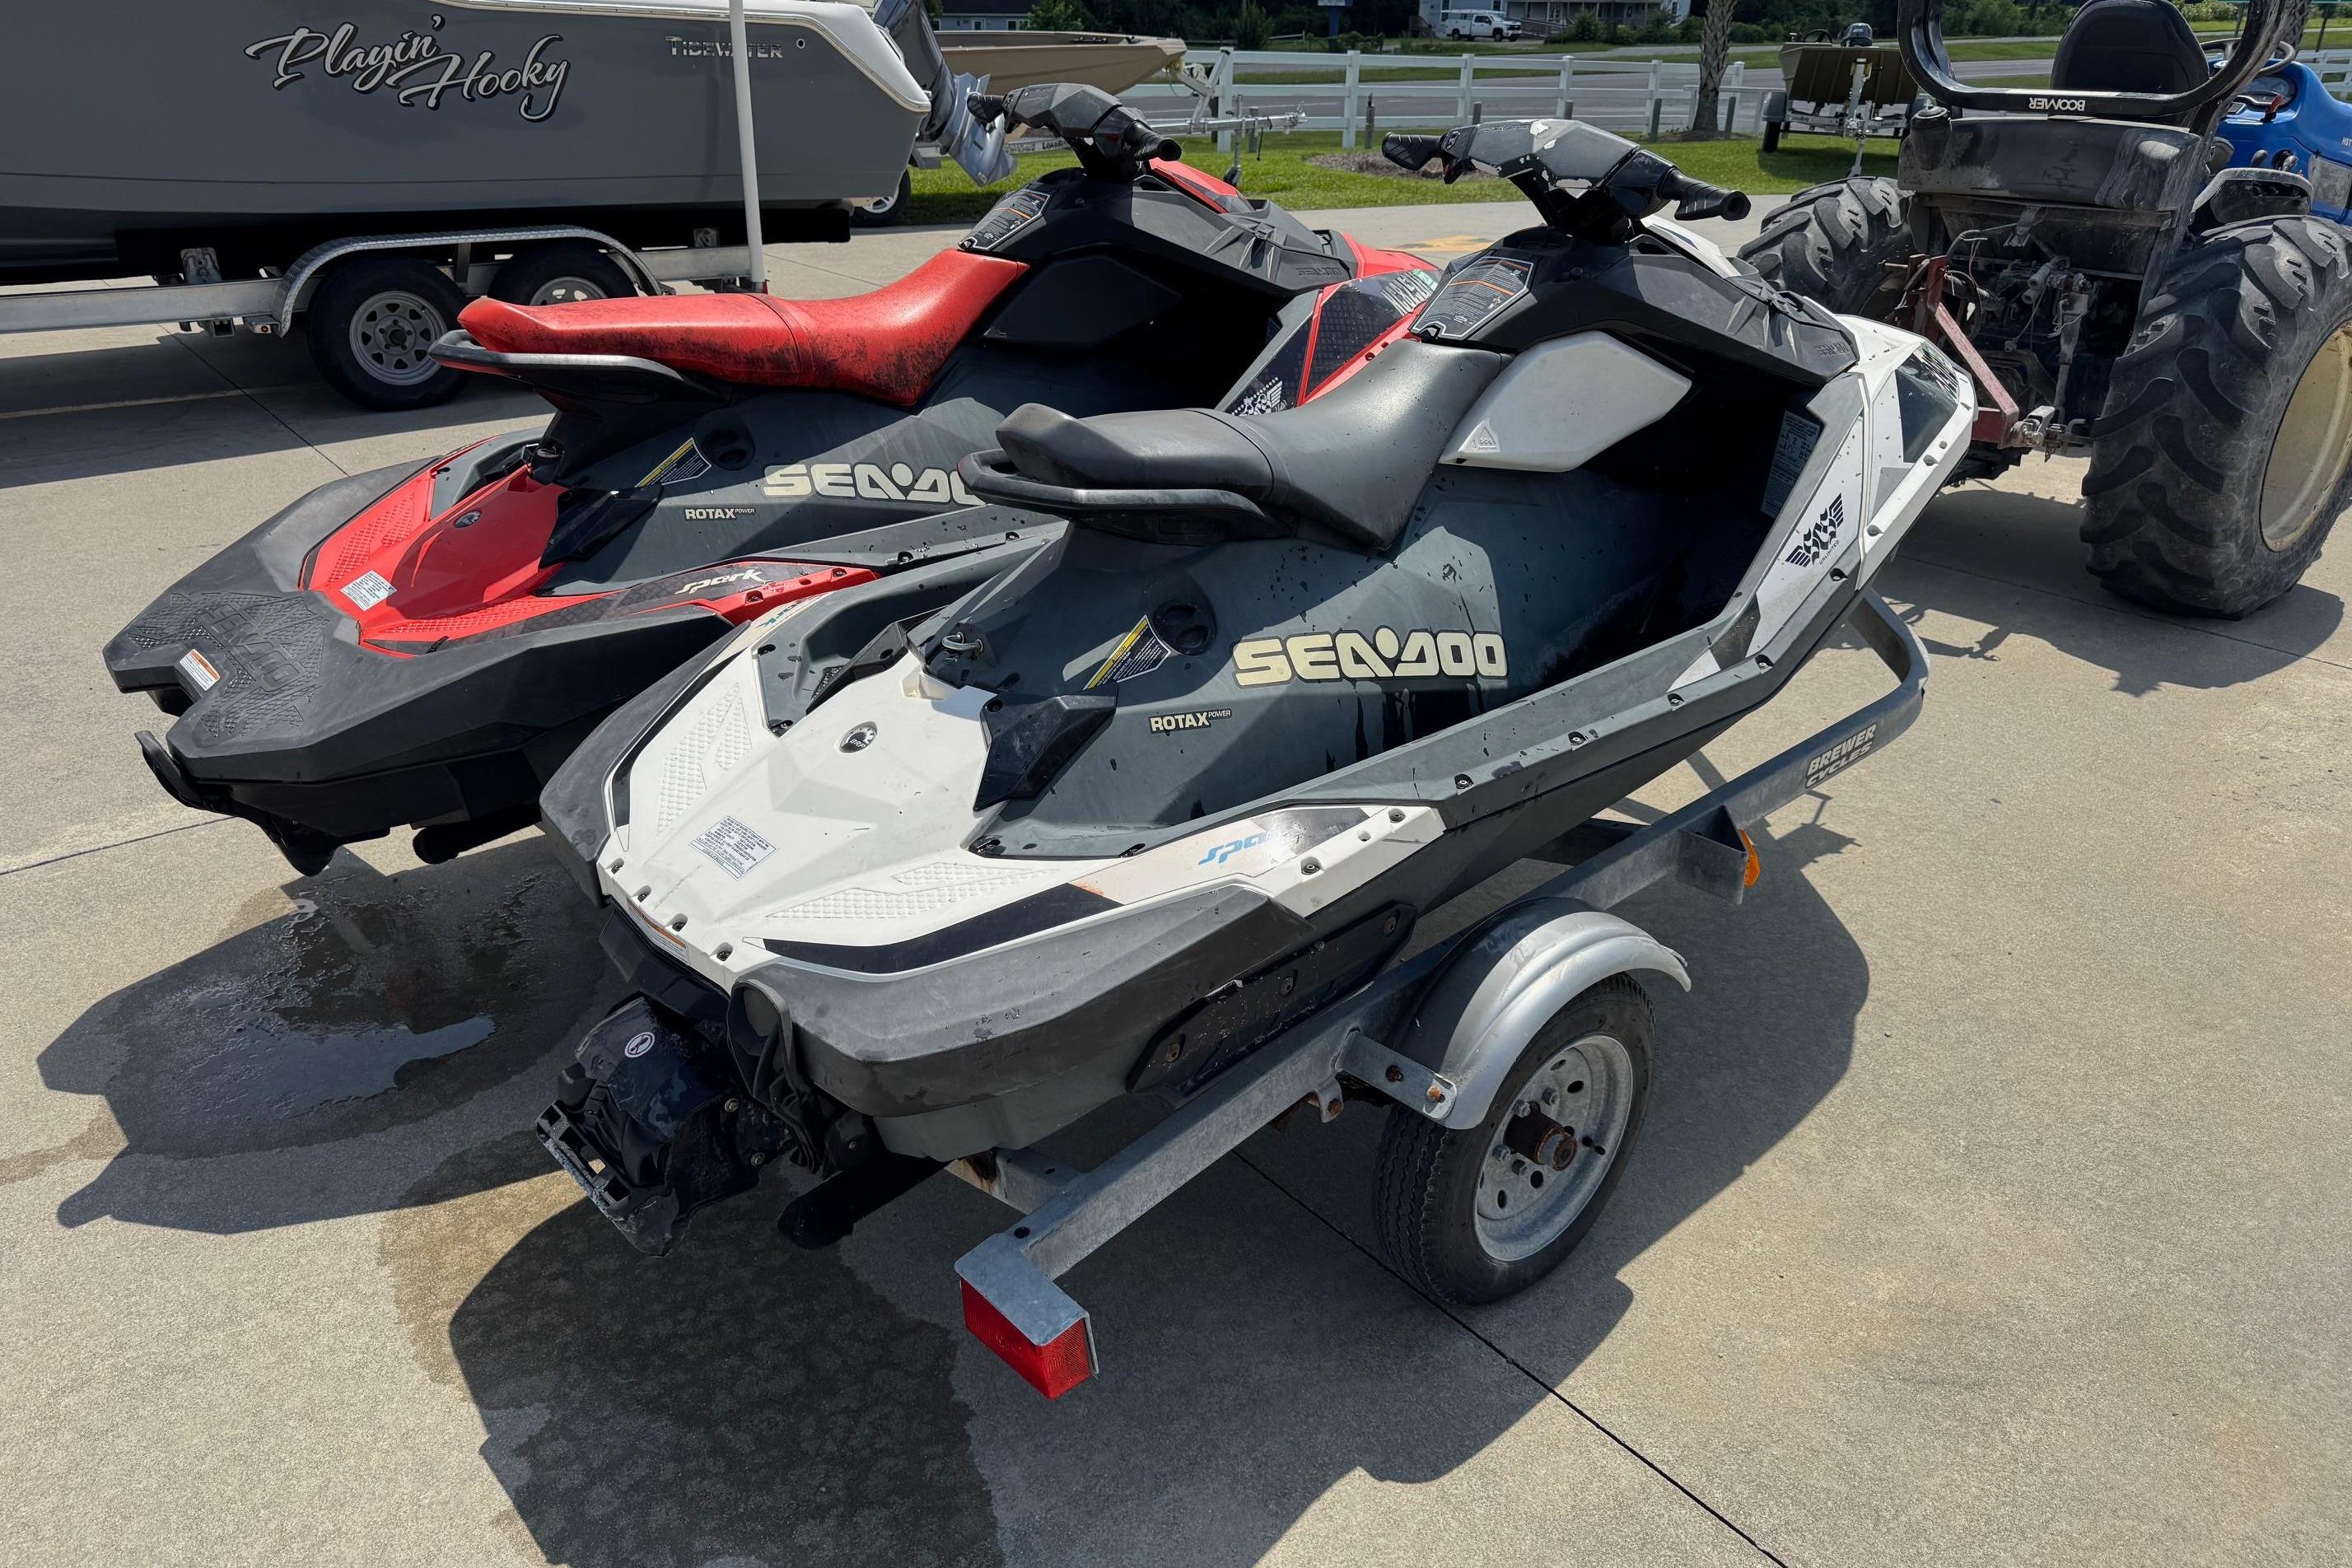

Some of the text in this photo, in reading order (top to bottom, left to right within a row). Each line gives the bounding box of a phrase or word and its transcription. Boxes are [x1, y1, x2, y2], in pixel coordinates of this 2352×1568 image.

[245, 15, 445, 93] Playin'
[665, 35, 783, 58] TIDEWTER
[385, 35, 570, 121] Hooky
[2028, 97, 2086, 112] BOOMER
[685, 508, 735, 520] ROTAX
[674, 568, 768, 595] spark
[1150, 710, 1231, 731] ROTAX POWER
[1807, 724, 1877, 776] BREWER
[1805, 741, 1873, 787] CYCLES
